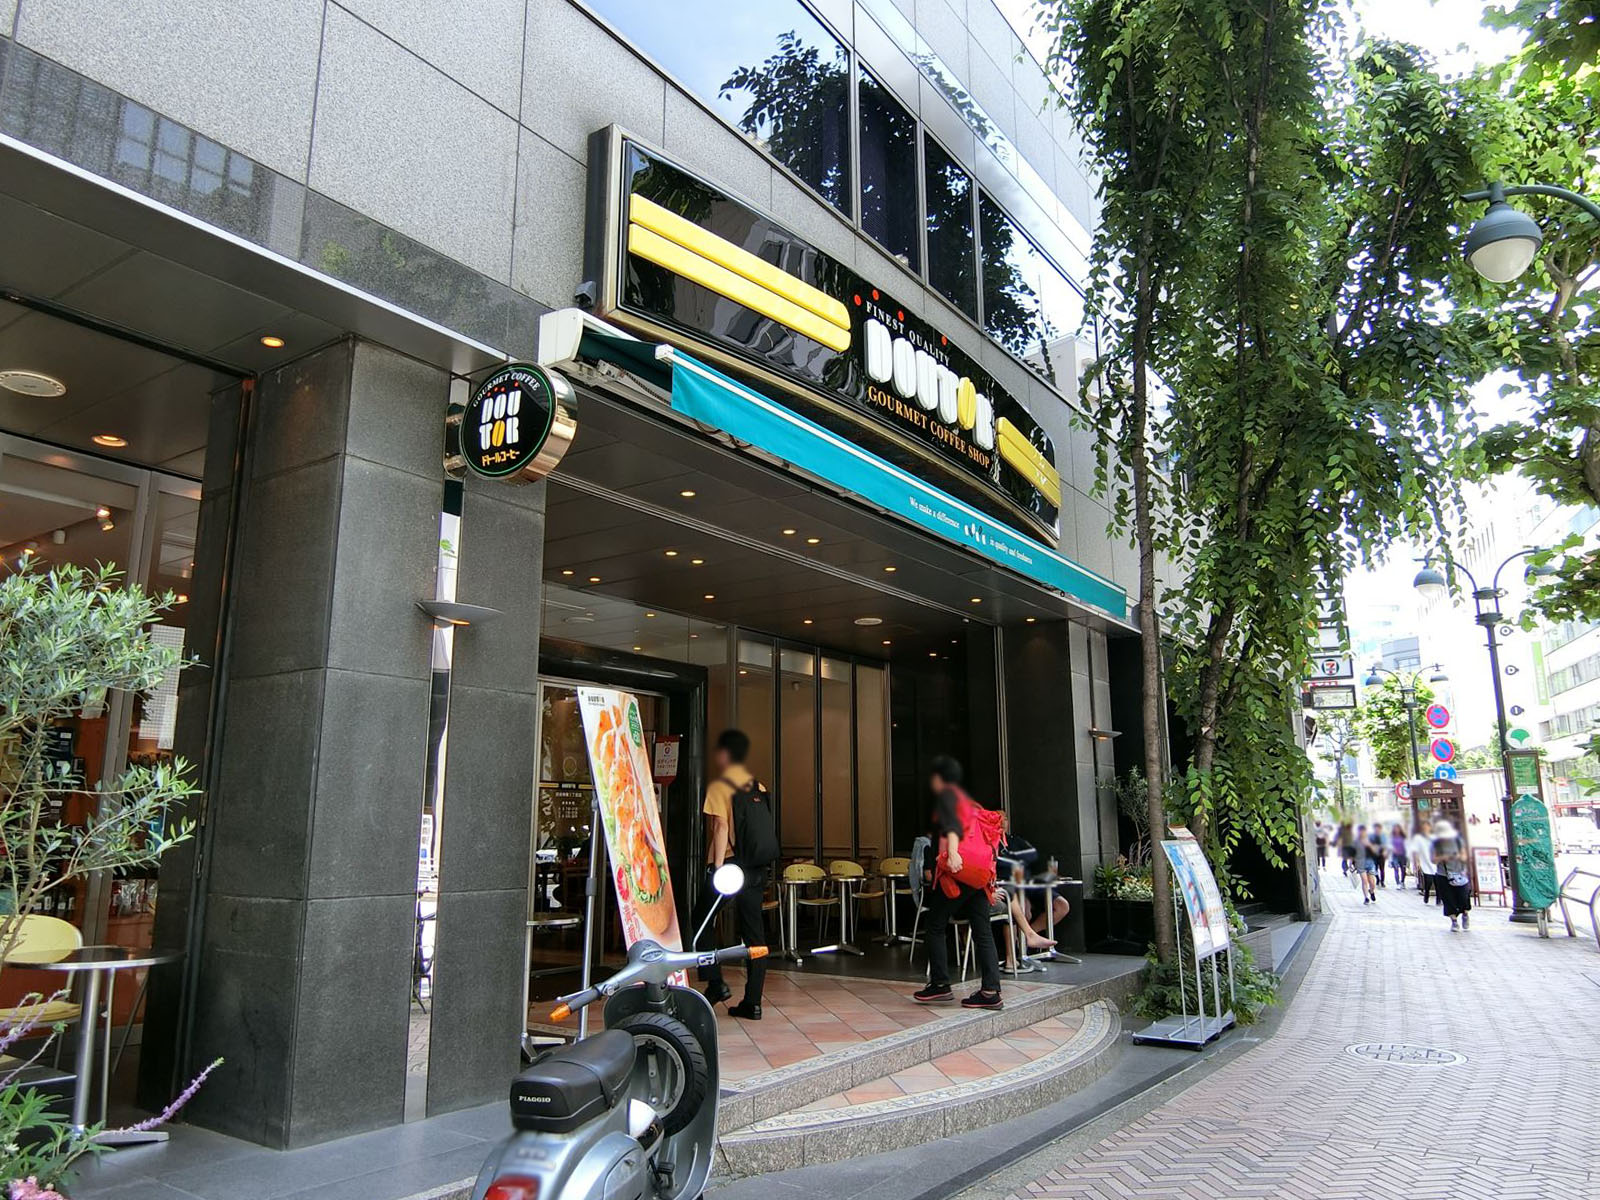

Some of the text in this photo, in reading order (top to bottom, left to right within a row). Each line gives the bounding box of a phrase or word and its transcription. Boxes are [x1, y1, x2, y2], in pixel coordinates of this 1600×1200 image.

[866, 300, 950, 367] FINEST QUALITY
[473, 372, 541, 408] GOURMET COFFEE
[863, 318, 994, 451] DOUTOR
[868, 385, 990, 468] GOURMET COFFEE SHOP
[481, 449, 520, 467] ドトールコーヒー
[518, 1095, 551, 1103] PIAGGIO
